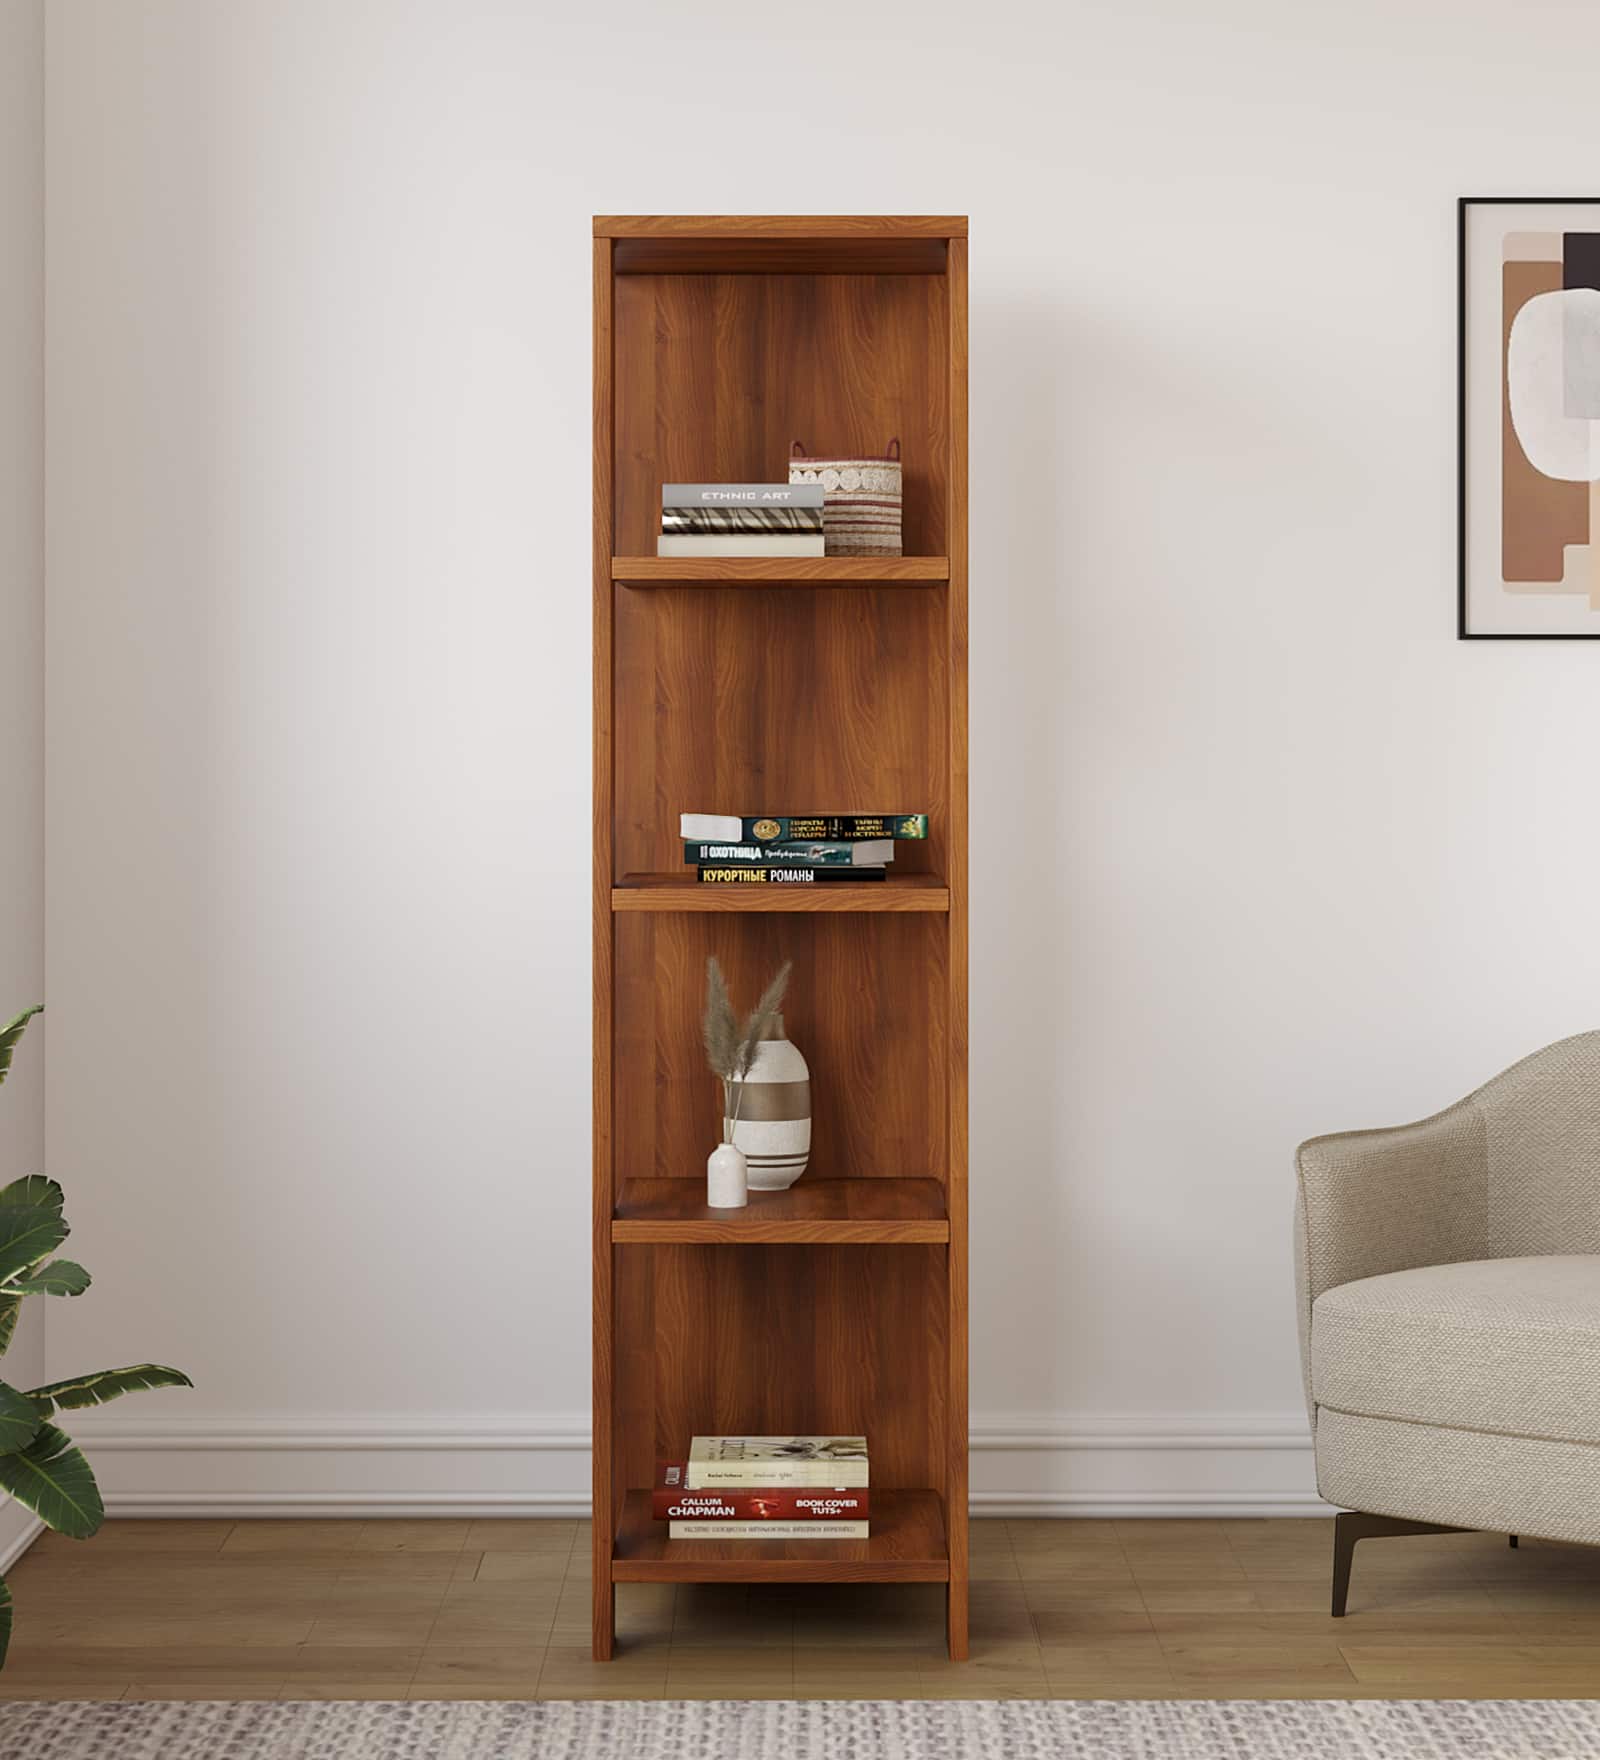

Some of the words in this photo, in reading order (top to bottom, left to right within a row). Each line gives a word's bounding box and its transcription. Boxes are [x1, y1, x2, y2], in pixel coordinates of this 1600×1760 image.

[701, 491, 757, 500] ETHNIC
[759, 491, 792, 500] ART
[709, 846, 763, 860] ОХОТНИЦА
[703, 869, 767, 882] КУРОРТНЫЕ
[770, 869, 815, 882] РОМАНЫ
[680, 1498, 723, 1506] CALLUM
[795, 1499, 825, 1508] BOOK
[825, 1499, 858, 1508] COVER
[667, 1506, 735, 1516] CHAPMAN
[811, 1507, 842, 1515] TUTS+
